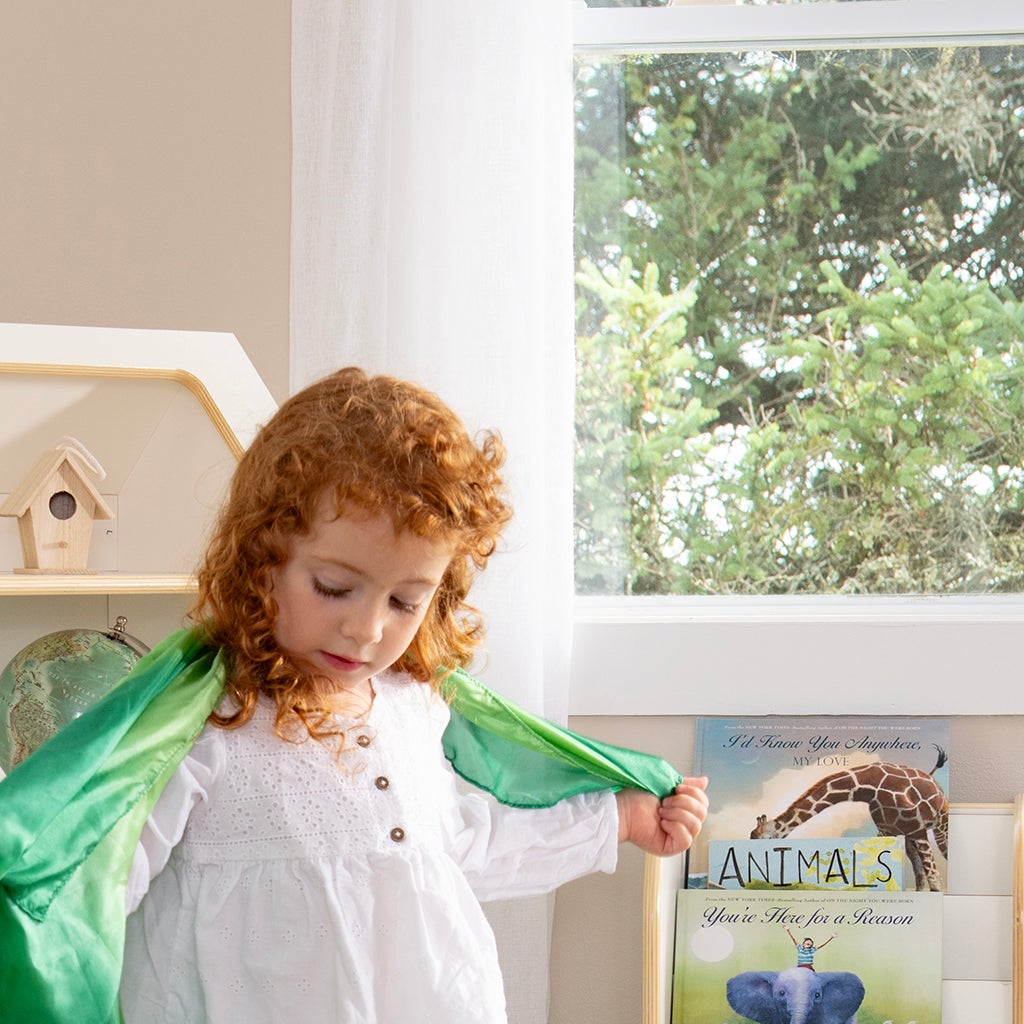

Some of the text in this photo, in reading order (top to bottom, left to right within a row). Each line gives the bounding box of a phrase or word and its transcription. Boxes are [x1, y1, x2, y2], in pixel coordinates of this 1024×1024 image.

[723, 734, 922, 753] I'd Know You Anywhere,
[793, 756, 849, 767] MY LOVE
[718, 846, 893, 888] ANIMALS
[701, 905, 914, 929] You're Here for a Reason
